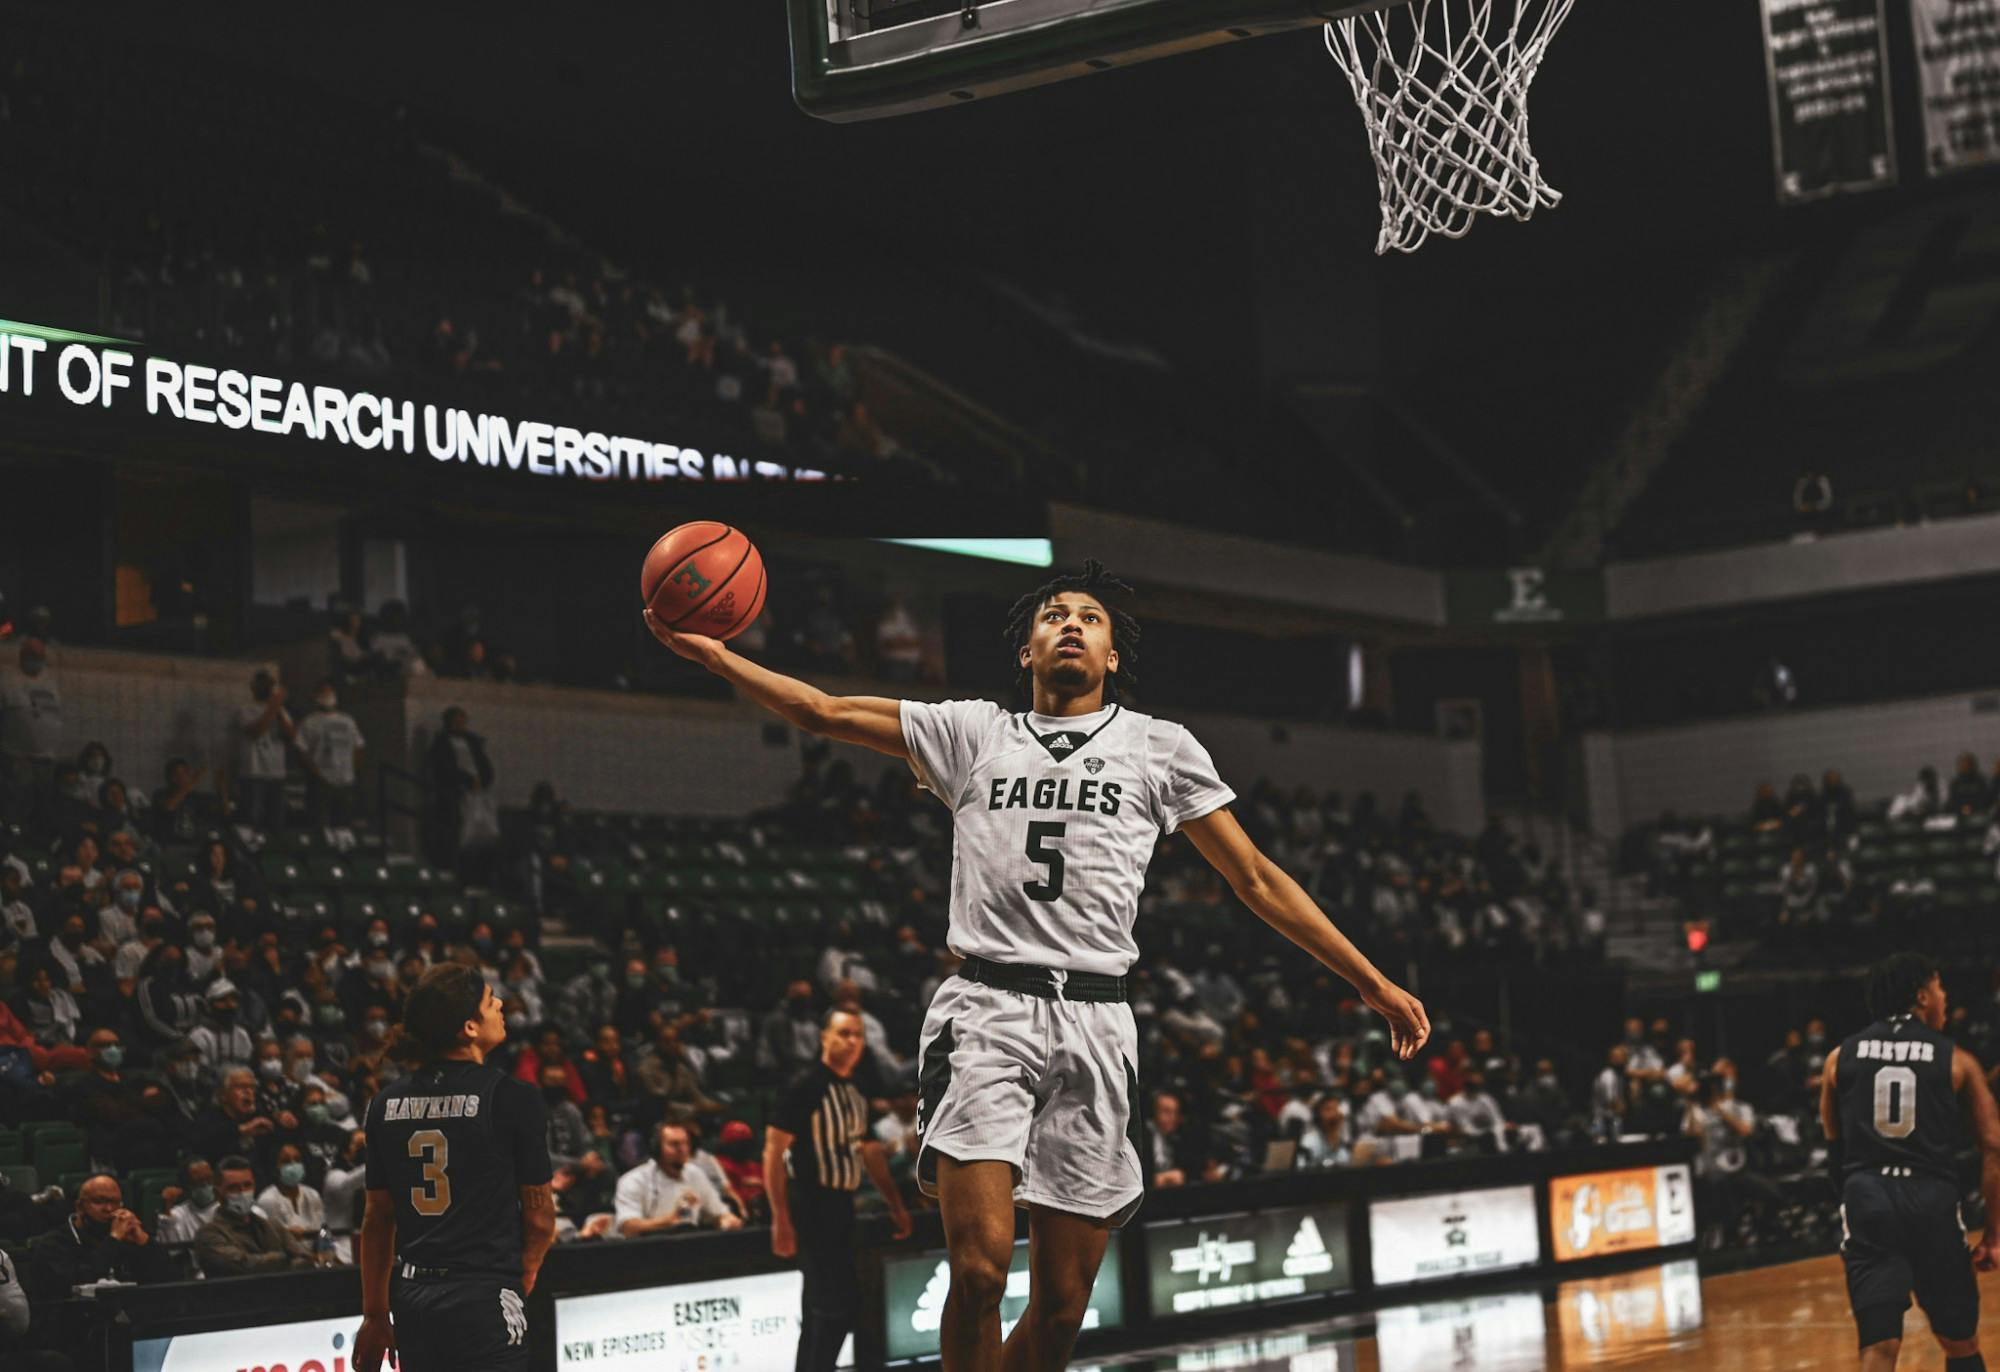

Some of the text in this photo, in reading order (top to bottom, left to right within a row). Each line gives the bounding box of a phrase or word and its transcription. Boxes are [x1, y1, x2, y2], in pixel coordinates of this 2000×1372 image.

[0, 333, 47, 397] T
[58, 343, 134, 408] OF
[146, 357, 415, 454] RESEARCH
[424, 404, 705, 481] UNIVERSITIES
[988, 776, 1123, 817] EAGLES
[1022, 820, 1067, 902] 5
[1856, 1039, 1935, 1062] BREWER
[384, 1094, 481, 1121] HAWKINS
[1873, 1065, 1917, 1139] 0
[408, 1128, 452, 1217] 3
[674, 1296, 742, 1327] EASTERN
[563, 1341, 595, 1362] NEW
